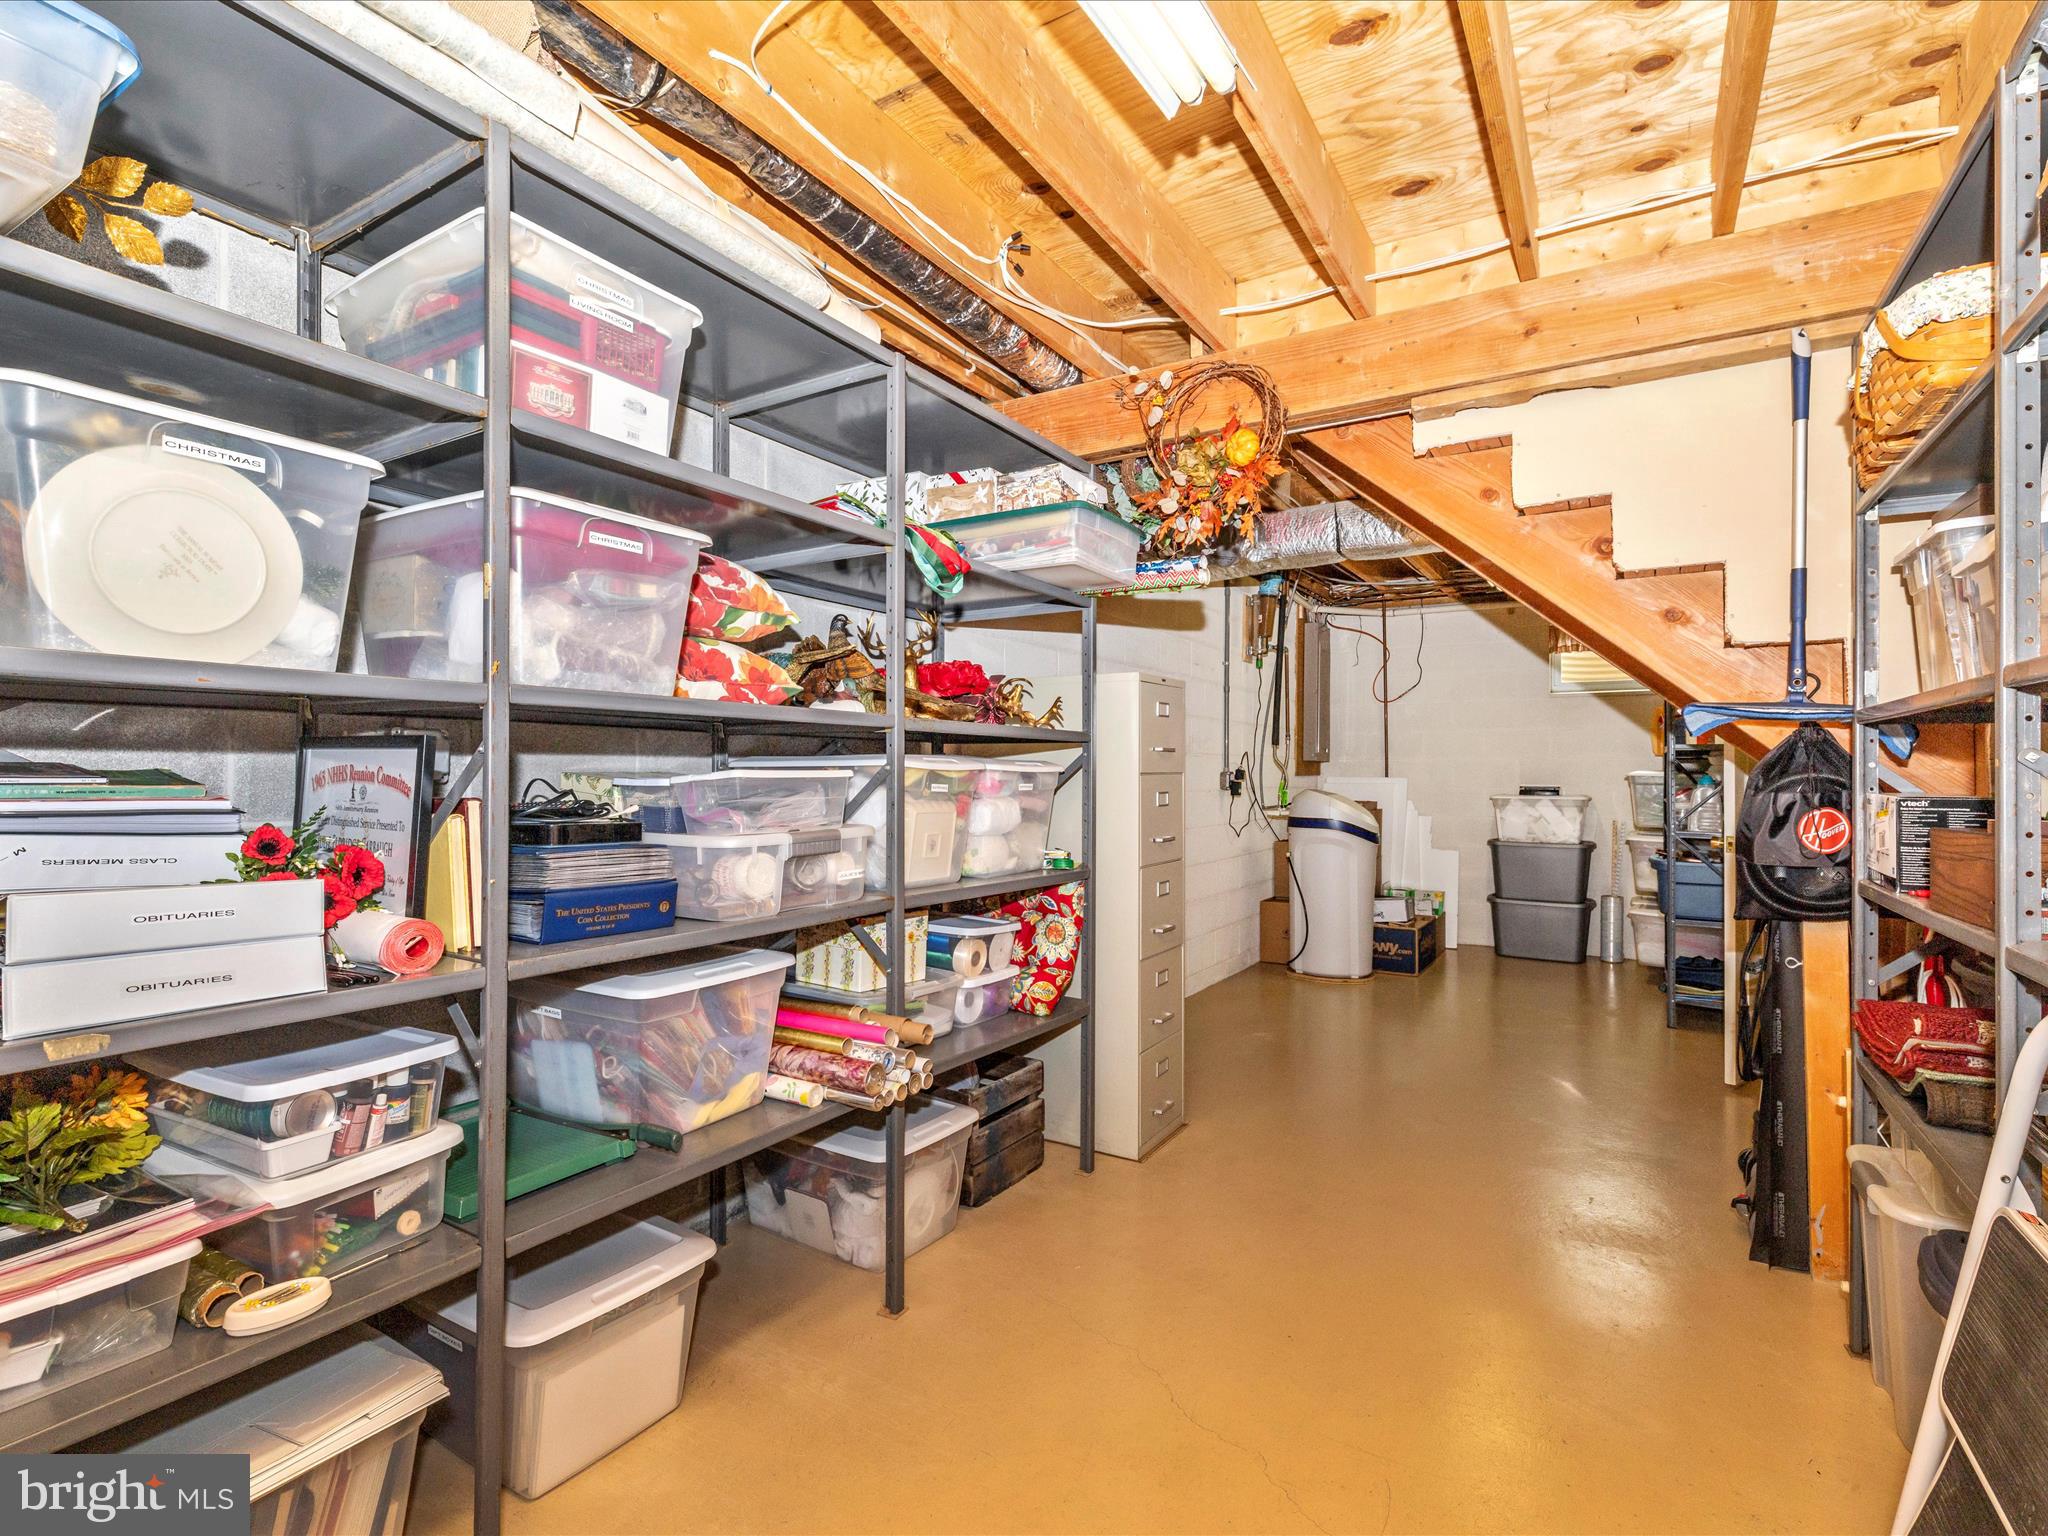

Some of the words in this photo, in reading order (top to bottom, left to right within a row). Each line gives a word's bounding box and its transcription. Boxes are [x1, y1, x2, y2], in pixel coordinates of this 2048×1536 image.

[578, 277, 632, 306] CHRISTMAS
[571, 299, 603, 316] LIVING
[604, 313, 632, 329] ROOM
[164, 440, 262, 468] CHRISTMAS
[590, 534, 642, 551] CHRISTMAS
[326, 764, 349, 785] NHHS
[349, 764, 375, 784] Reunion
[376, 766, 412, 799] Committee
[330, 815, 359, 830] Distinguished
[360, 818, 376, 829] Service
[376, 818, 398, 831] Presented
[398, 821, 405, 832] To
[1802, 810, 1846, 849] HOOVER
[41, 858, 124, 866] MEMBERS
[129, 857, 178, 865] CLASS
[133, 909, 235, 923] OBITUARIES
[555, 909, 570, 917] THE
[571, 907, 594, 915] UNITED
[595, 904, 618, 913] STATES
[618, 902, 650, 911] PRESIDENTS
[577, 916, 593, 924] COIN
[594, 913, 630, 922] COLLECTION
[125, 974, 233, 993] OBITUARIES
